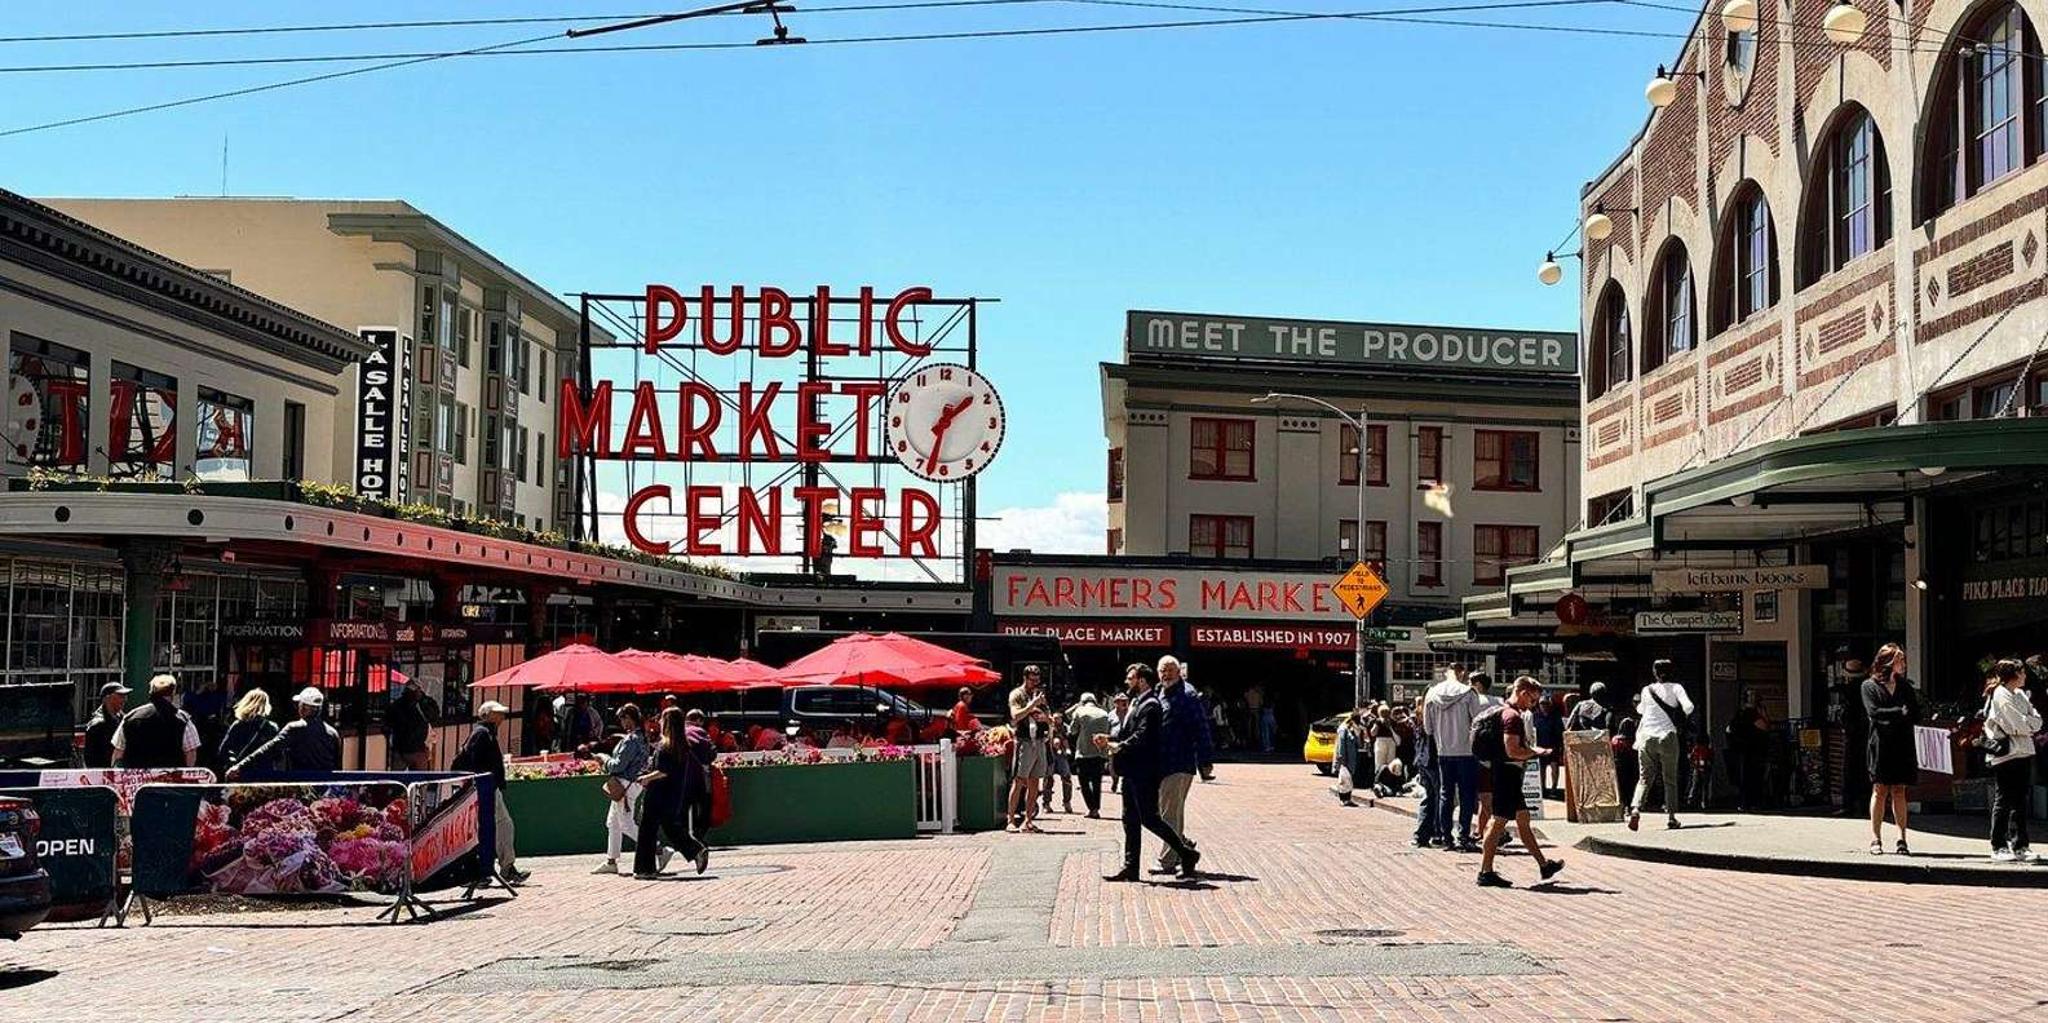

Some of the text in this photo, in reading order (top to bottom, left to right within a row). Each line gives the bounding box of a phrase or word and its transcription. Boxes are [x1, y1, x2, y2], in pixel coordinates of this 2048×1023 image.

[644, 284, 932, 357] PUBLIC
[1147, 318, 1562, 368] MEET THE PRODUCER
[915, 373, 927, 387] 11
[939, 367, 952, 380] 12
[966, 373, 973, 387] 1
[898, 391, 910, 404] 10
[983, 392, 992, 406] 2
[559, 378, 887, 462] MARKET
[892, 416, 902, 429] 9
[988, 416, 997, 429] 3
[898, 439, 908, 452] 8
[980, 440, 991, 453] 4
[915, 457, 924, 470] 7
[939, 463, 949, 476] 6
[965, 458, 974, 471] 5
[622, 484, 942, 560] CENTER
[1006, 575, 1346, 613] FARMERS MARKE
[1963, 582, 1989, 600] PIKE
[1991, 578, 2025, 598] PLACE
[1640, 614, 1660, 626] The
[330, 622, 378, 639] INFORMATION
[1046, 627, 1096, 641] PLACE
[1100, 628, 1163, 642] MARKET
[1196, 629, 1351, 646] ESTABLISHED IN 1907
[36, 838, 95, 857] OPEN
